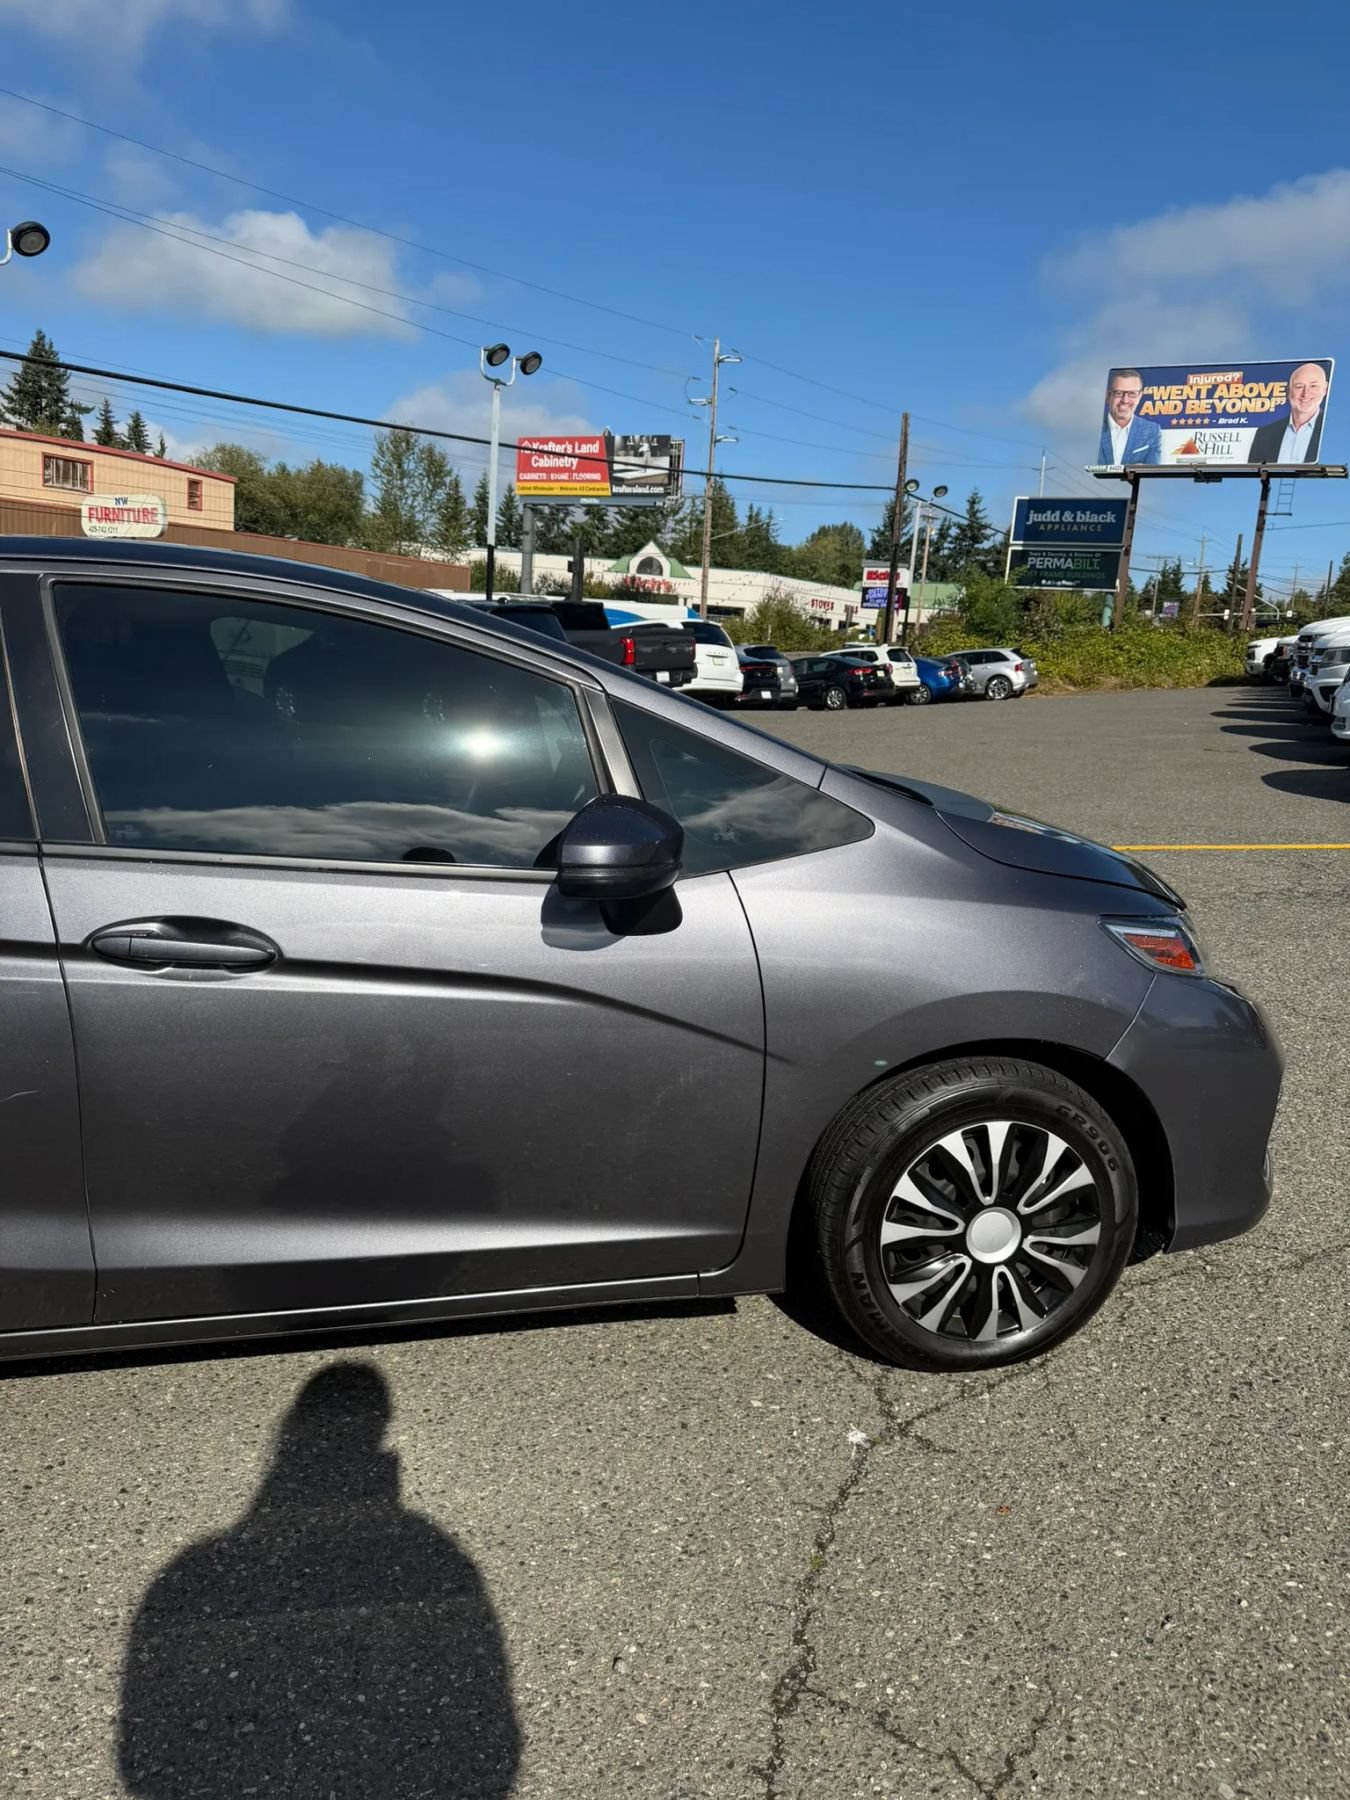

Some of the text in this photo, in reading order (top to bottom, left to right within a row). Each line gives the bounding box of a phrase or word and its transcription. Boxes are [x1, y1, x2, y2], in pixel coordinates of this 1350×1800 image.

[1213, 382, 1288, 398] ABOVE
[1139, 400, 1183, 416] AND
[1218, 417, 1239, 425] Brad
[1193, 431, 1242, 444] RUSSELL
[532, 440, 600, 454] Krafter's Land
[531, 455, 579, 470] Cabinetry
[519, 472, 602, 481] CABINETS STONE FLOORING
[612, 484, 665, 494] kraftersland.com
[114, 496, 129, 506] NW
[87, 506, 159, 525] FURNITURE
[1026, 510, 1117, 525] judd & black
[1039, 523, 1102, 532] APPLIANCE
[811, 599, 834, 610] STOVES
[1056, 1104, 1120, 1172] GR906
